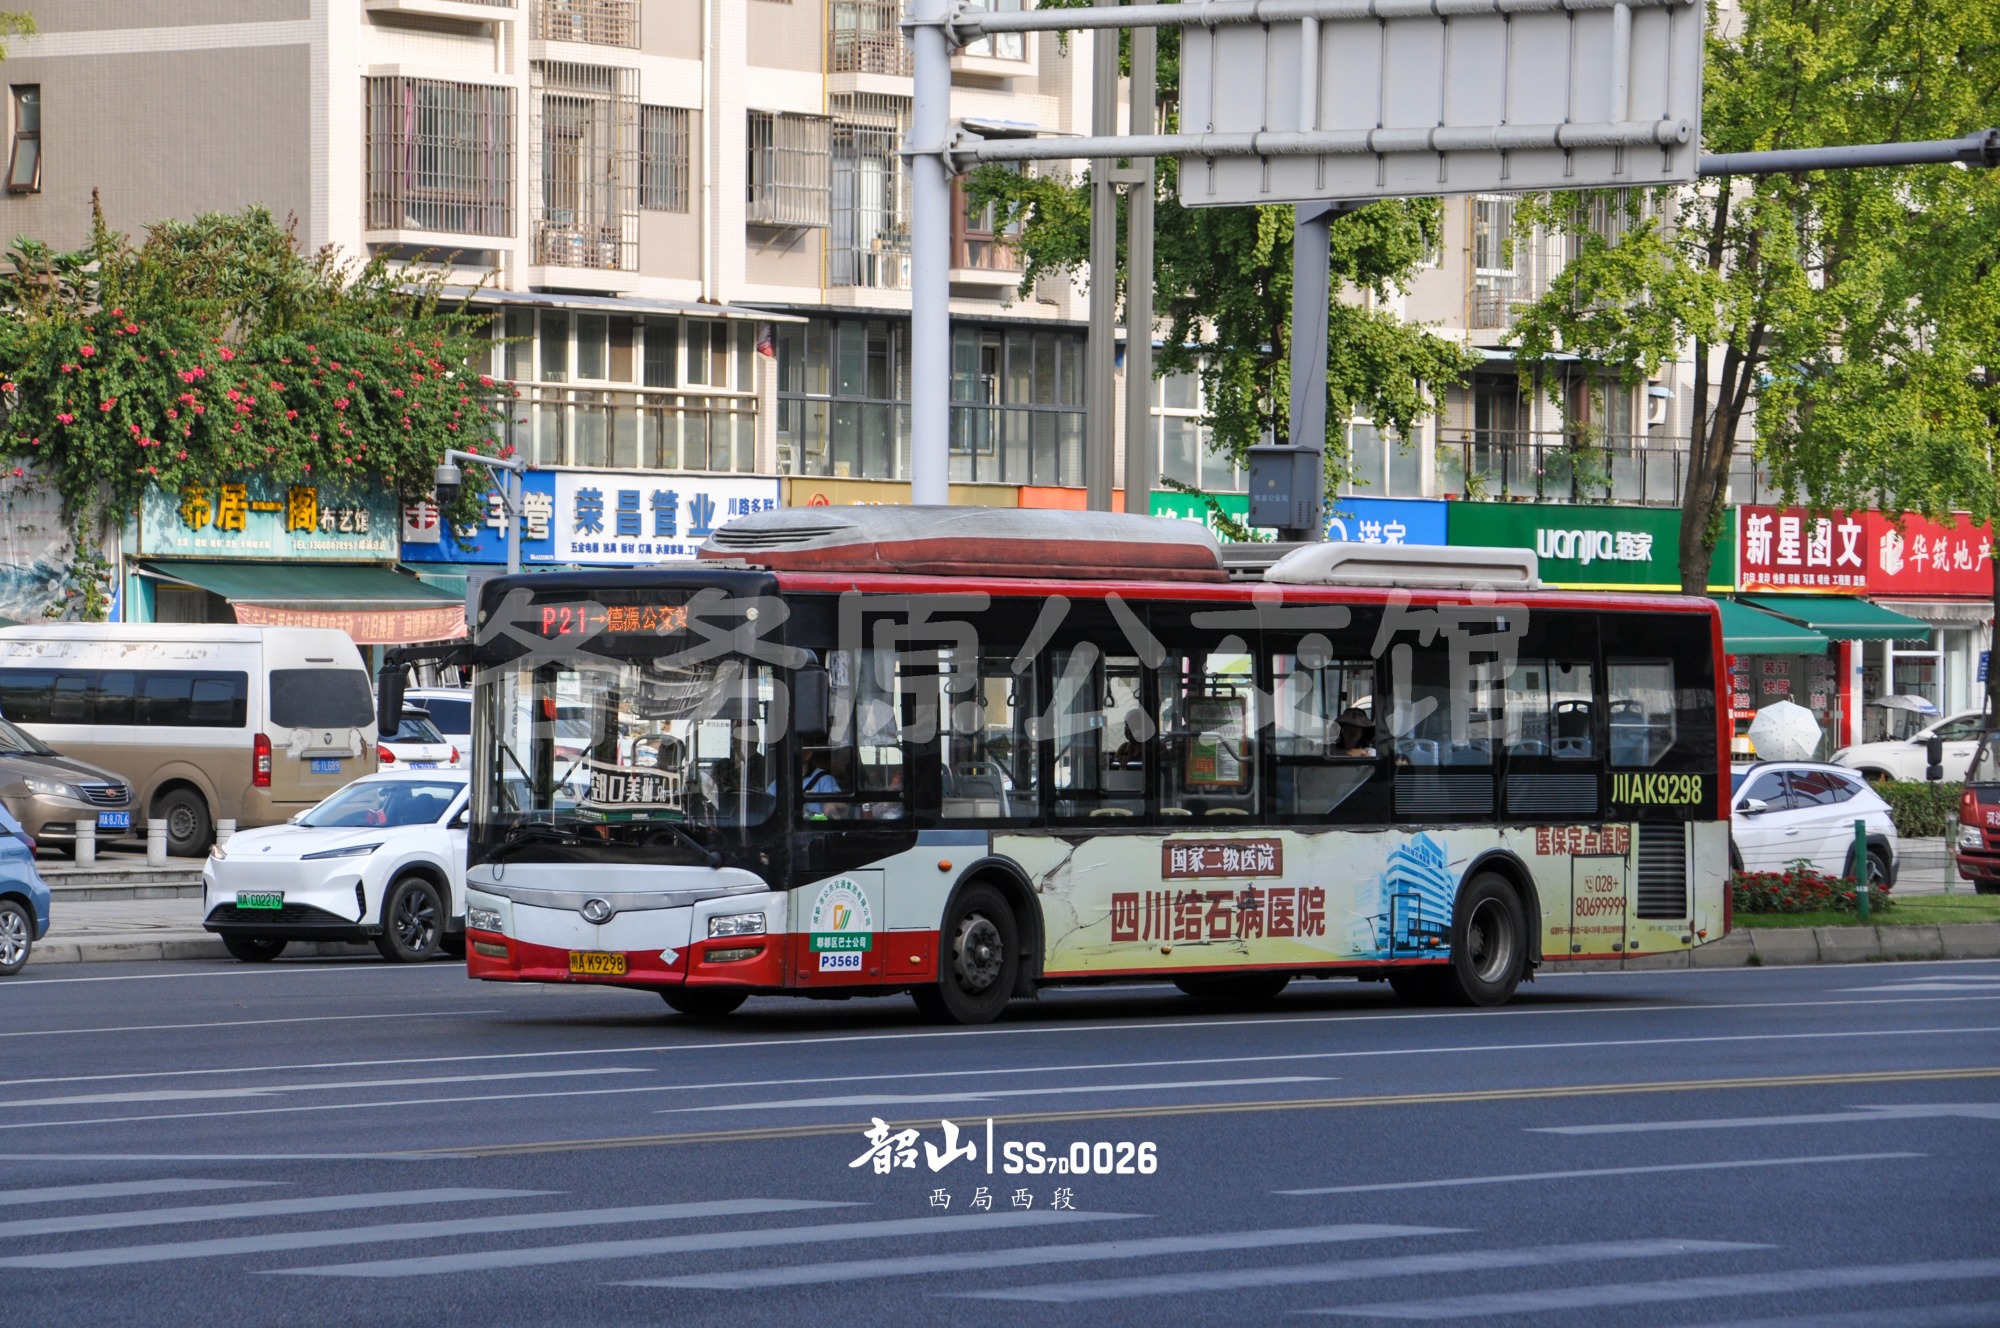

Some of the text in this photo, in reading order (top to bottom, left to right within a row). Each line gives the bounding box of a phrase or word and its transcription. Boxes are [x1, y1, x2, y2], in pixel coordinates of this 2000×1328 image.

[320, 507, 370, 532] 布艺馆
[455, 491, 553, 540] 丰管
[572, 487, 717, 538] 荣昌管业
[571, 542, 599, 553] 五金电器
[1746, 513, 1863, 568] 新星图文
[1909, 533, 1991, 573] 华筑地产
[542, 605, 688, 635] P21 德源公交站
[1763, 660, 1789, 675] 装订
[1763, 679, 1789, 694] 快照
[1611, 773, 1702, 805] 川AK9298
[1535, 826, 1630, 856] 医保定点医院
[1170, 843, 1275, 873] 国家二级医院
[1595, 875, 1620, 893] 028+
[1111, 886, 1326, 942] 四川结石病医院
[1576, 896, 1627, 917] 80699999
[821, 955, 860, 968] P3568
